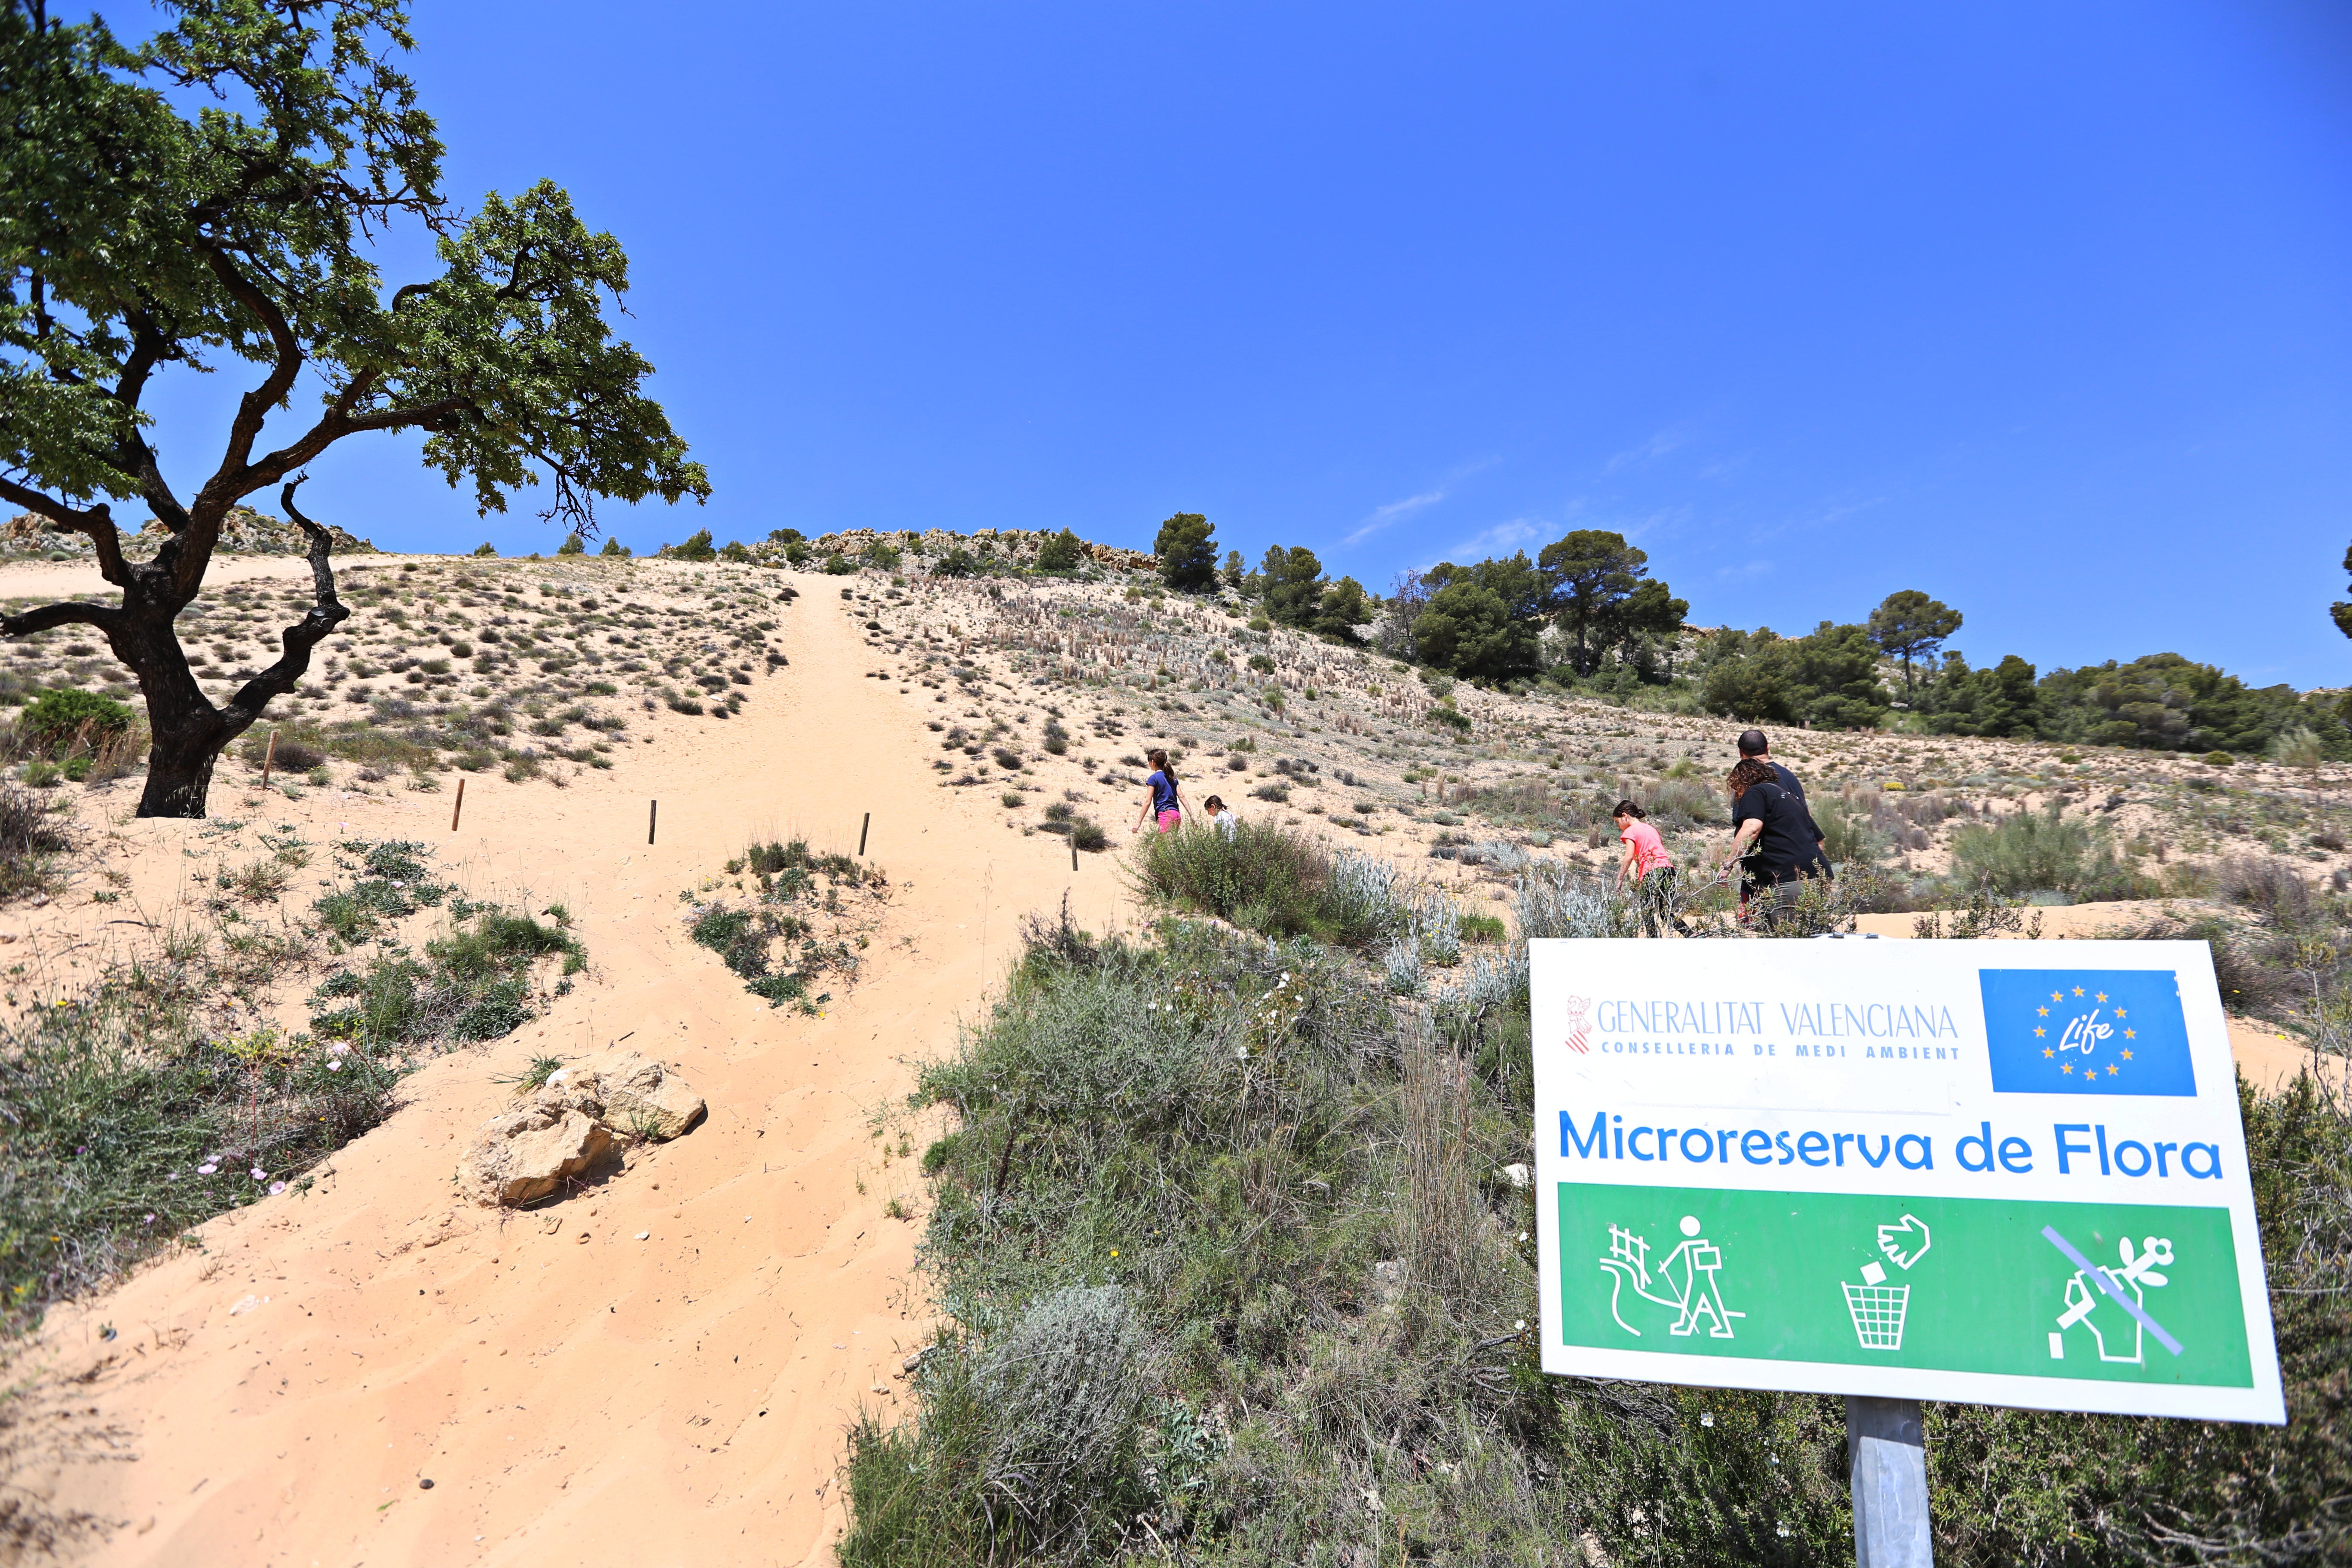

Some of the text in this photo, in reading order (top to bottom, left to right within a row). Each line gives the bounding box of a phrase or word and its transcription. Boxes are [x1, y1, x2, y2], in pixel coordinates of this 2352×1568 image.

[1598, 1001, 1958, 1038] GENERALITAT VALENCIANA
[2059, 1008, 2114, 1055] Life
[1602, 1041, 1959, 1060] CONSELLERIA DE MEDI AMBIENT
[1558, 1110, 2223, 1180] Microreserva de Flora
